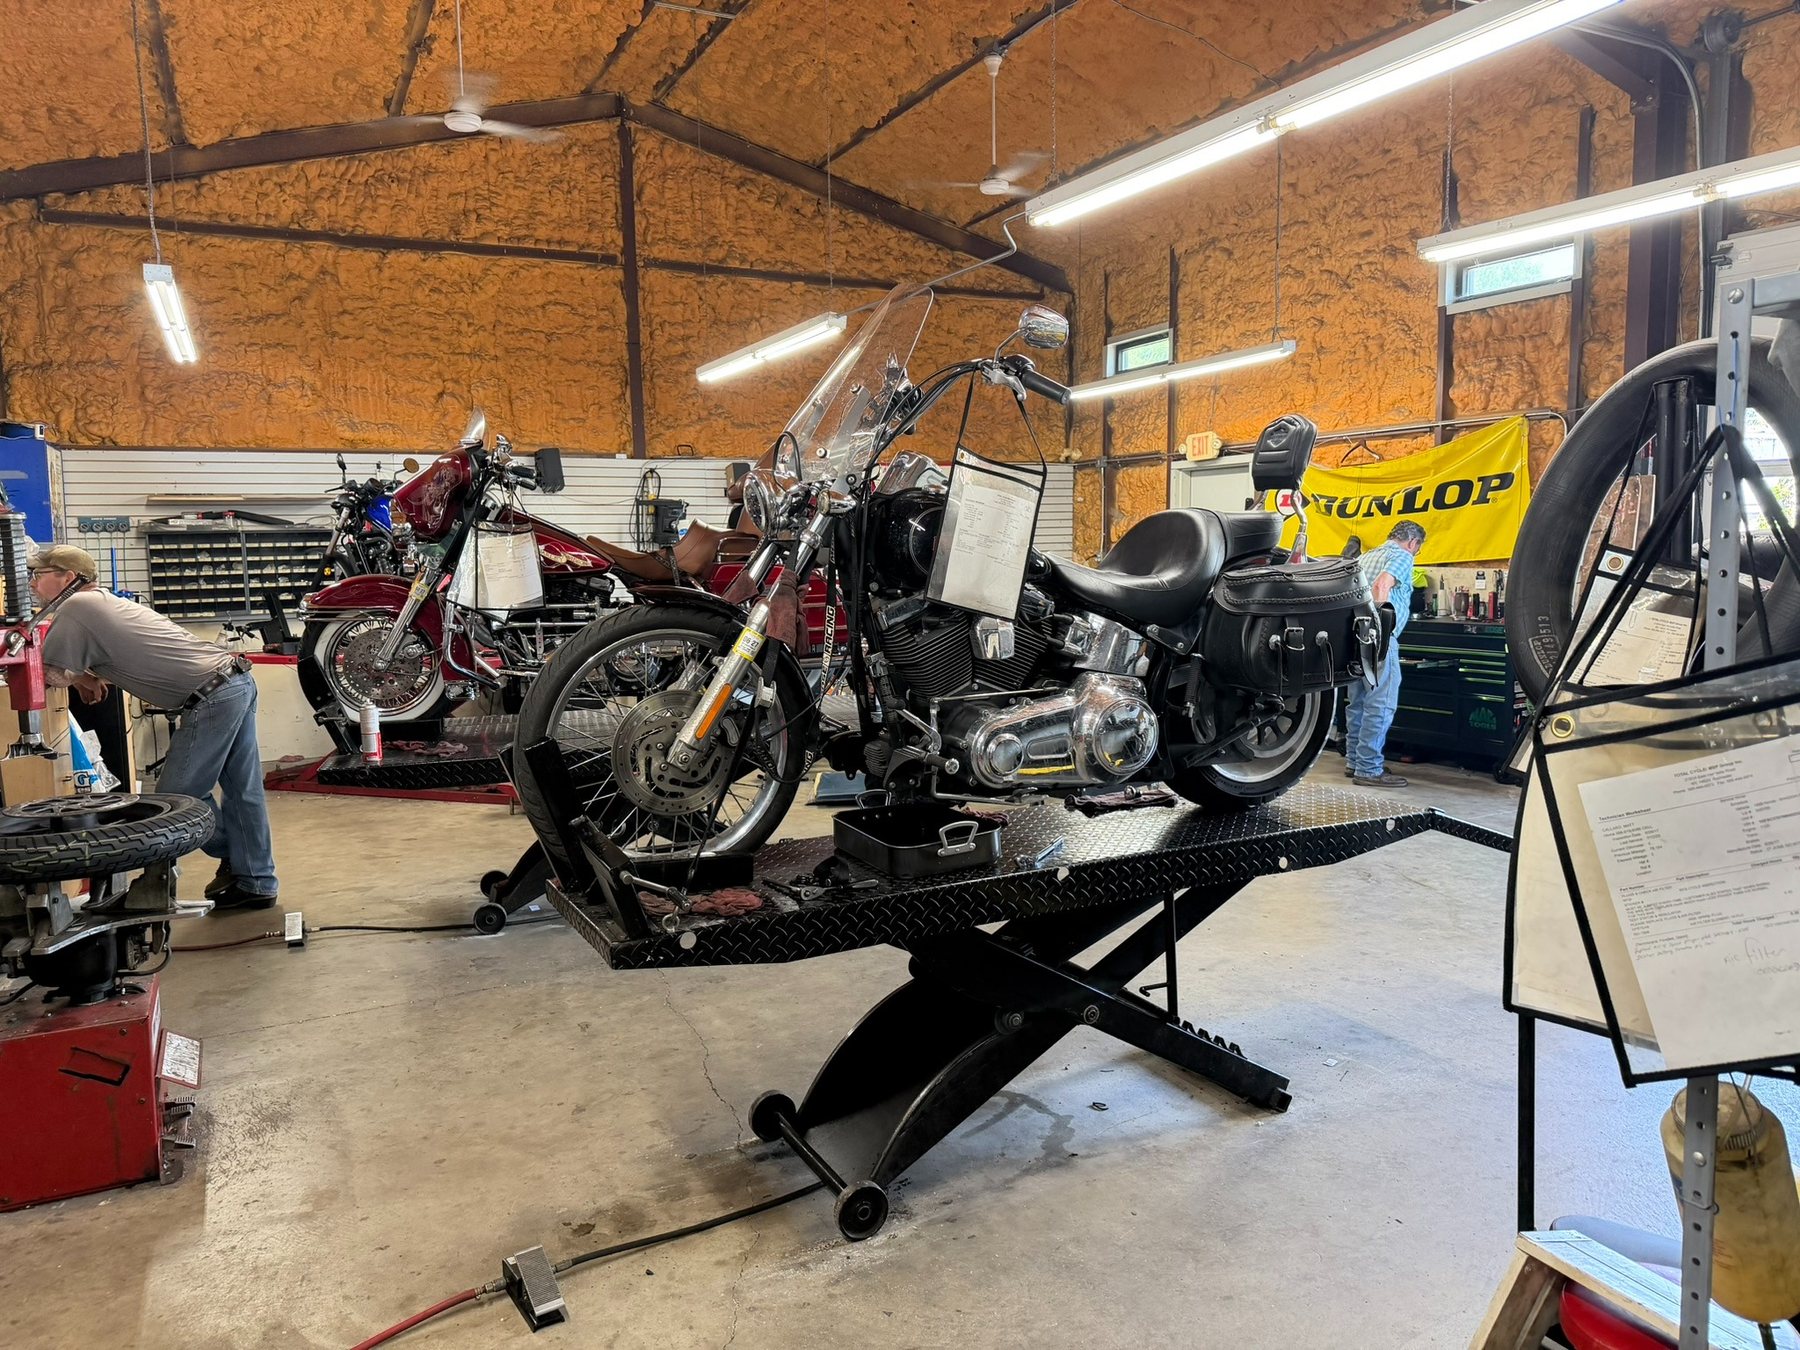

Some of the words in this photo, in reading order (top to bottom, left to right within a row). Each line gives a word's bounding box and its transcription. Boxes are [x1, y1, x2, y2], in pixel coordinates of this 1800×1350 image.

[1191, 436, 1209, 456] EXIT
[1311, 472, 1514, 518] DUNLOP
[824, 605, 836, 655] RACING
